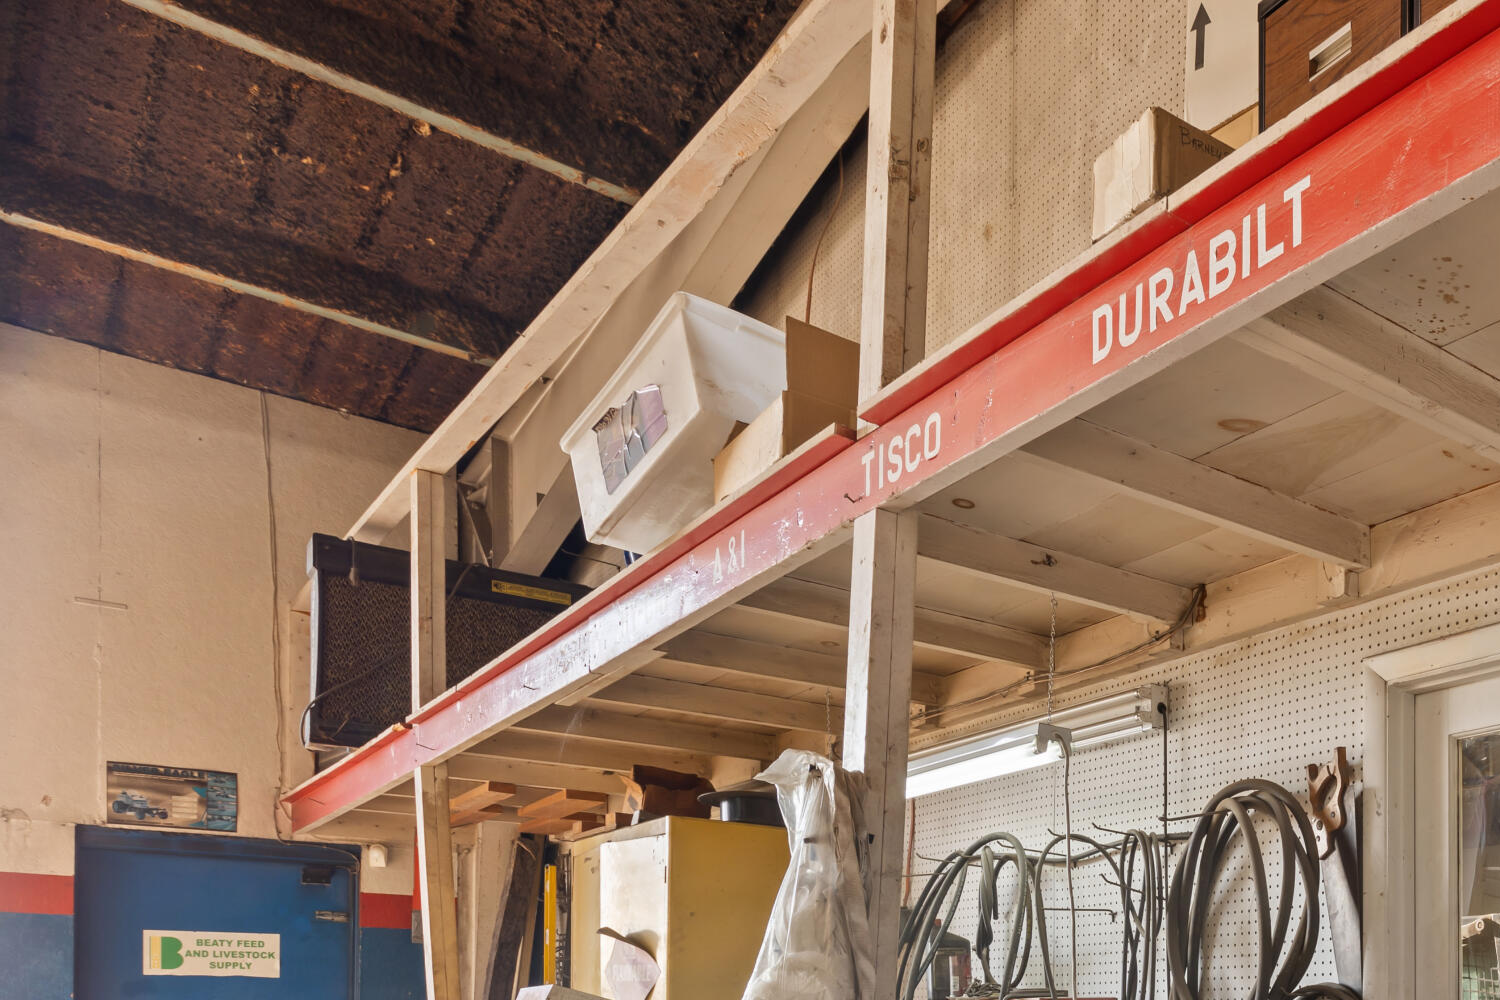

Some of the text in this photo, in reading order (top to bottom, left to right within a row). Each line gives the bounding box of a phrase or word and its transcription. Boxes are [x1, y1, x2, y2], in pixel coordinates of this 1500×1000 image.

[1092, 174, 1311, 365] DURABILT
[861, 411, 941, 498] TISCO
[196, 939, 265, 948] BEATY FEED
[185, 950, 275, 959] AND LIVESTOCK
[209, 961, 252, 970] SUPPLY
